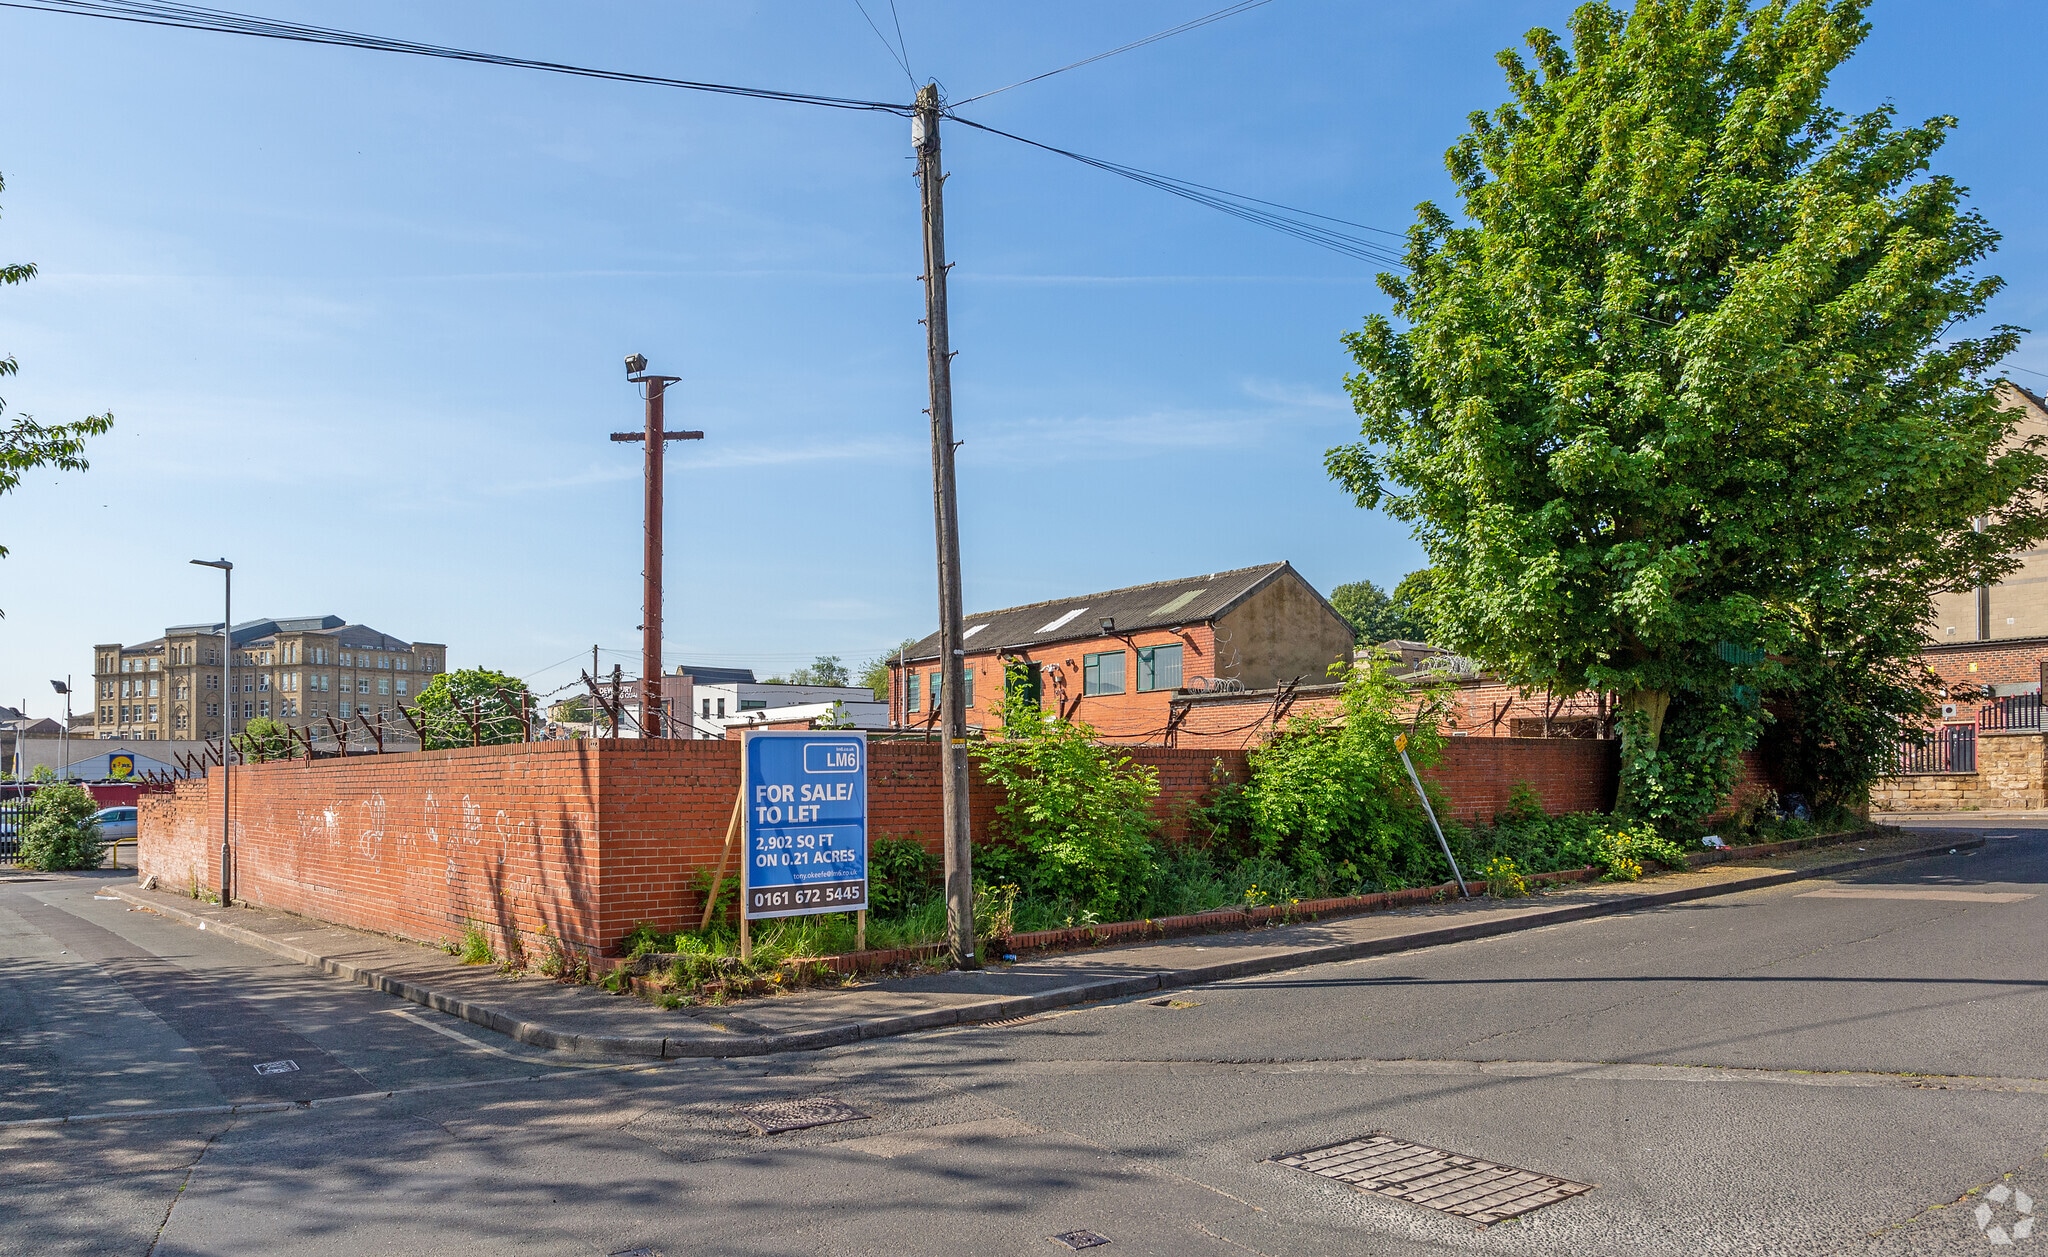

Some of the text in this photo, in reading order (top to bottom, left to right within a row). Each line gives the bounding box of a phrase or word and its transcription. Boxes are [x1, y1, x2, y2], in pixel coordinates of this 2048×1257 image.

[827, 753, 855, 767] LM6
[756, 783, 854, 803] FOR SALE/
[756, 805, 820, 824] TO LET
[756, 833, 834, 851] 2,902 SQ FT
[756, 849, 855, 867] ON 0.21 ACRES
[793, 869, 858, 880] tony.okeefe@lm6.co.uk
[754, 886, 860, 907] 0161 672 5445
